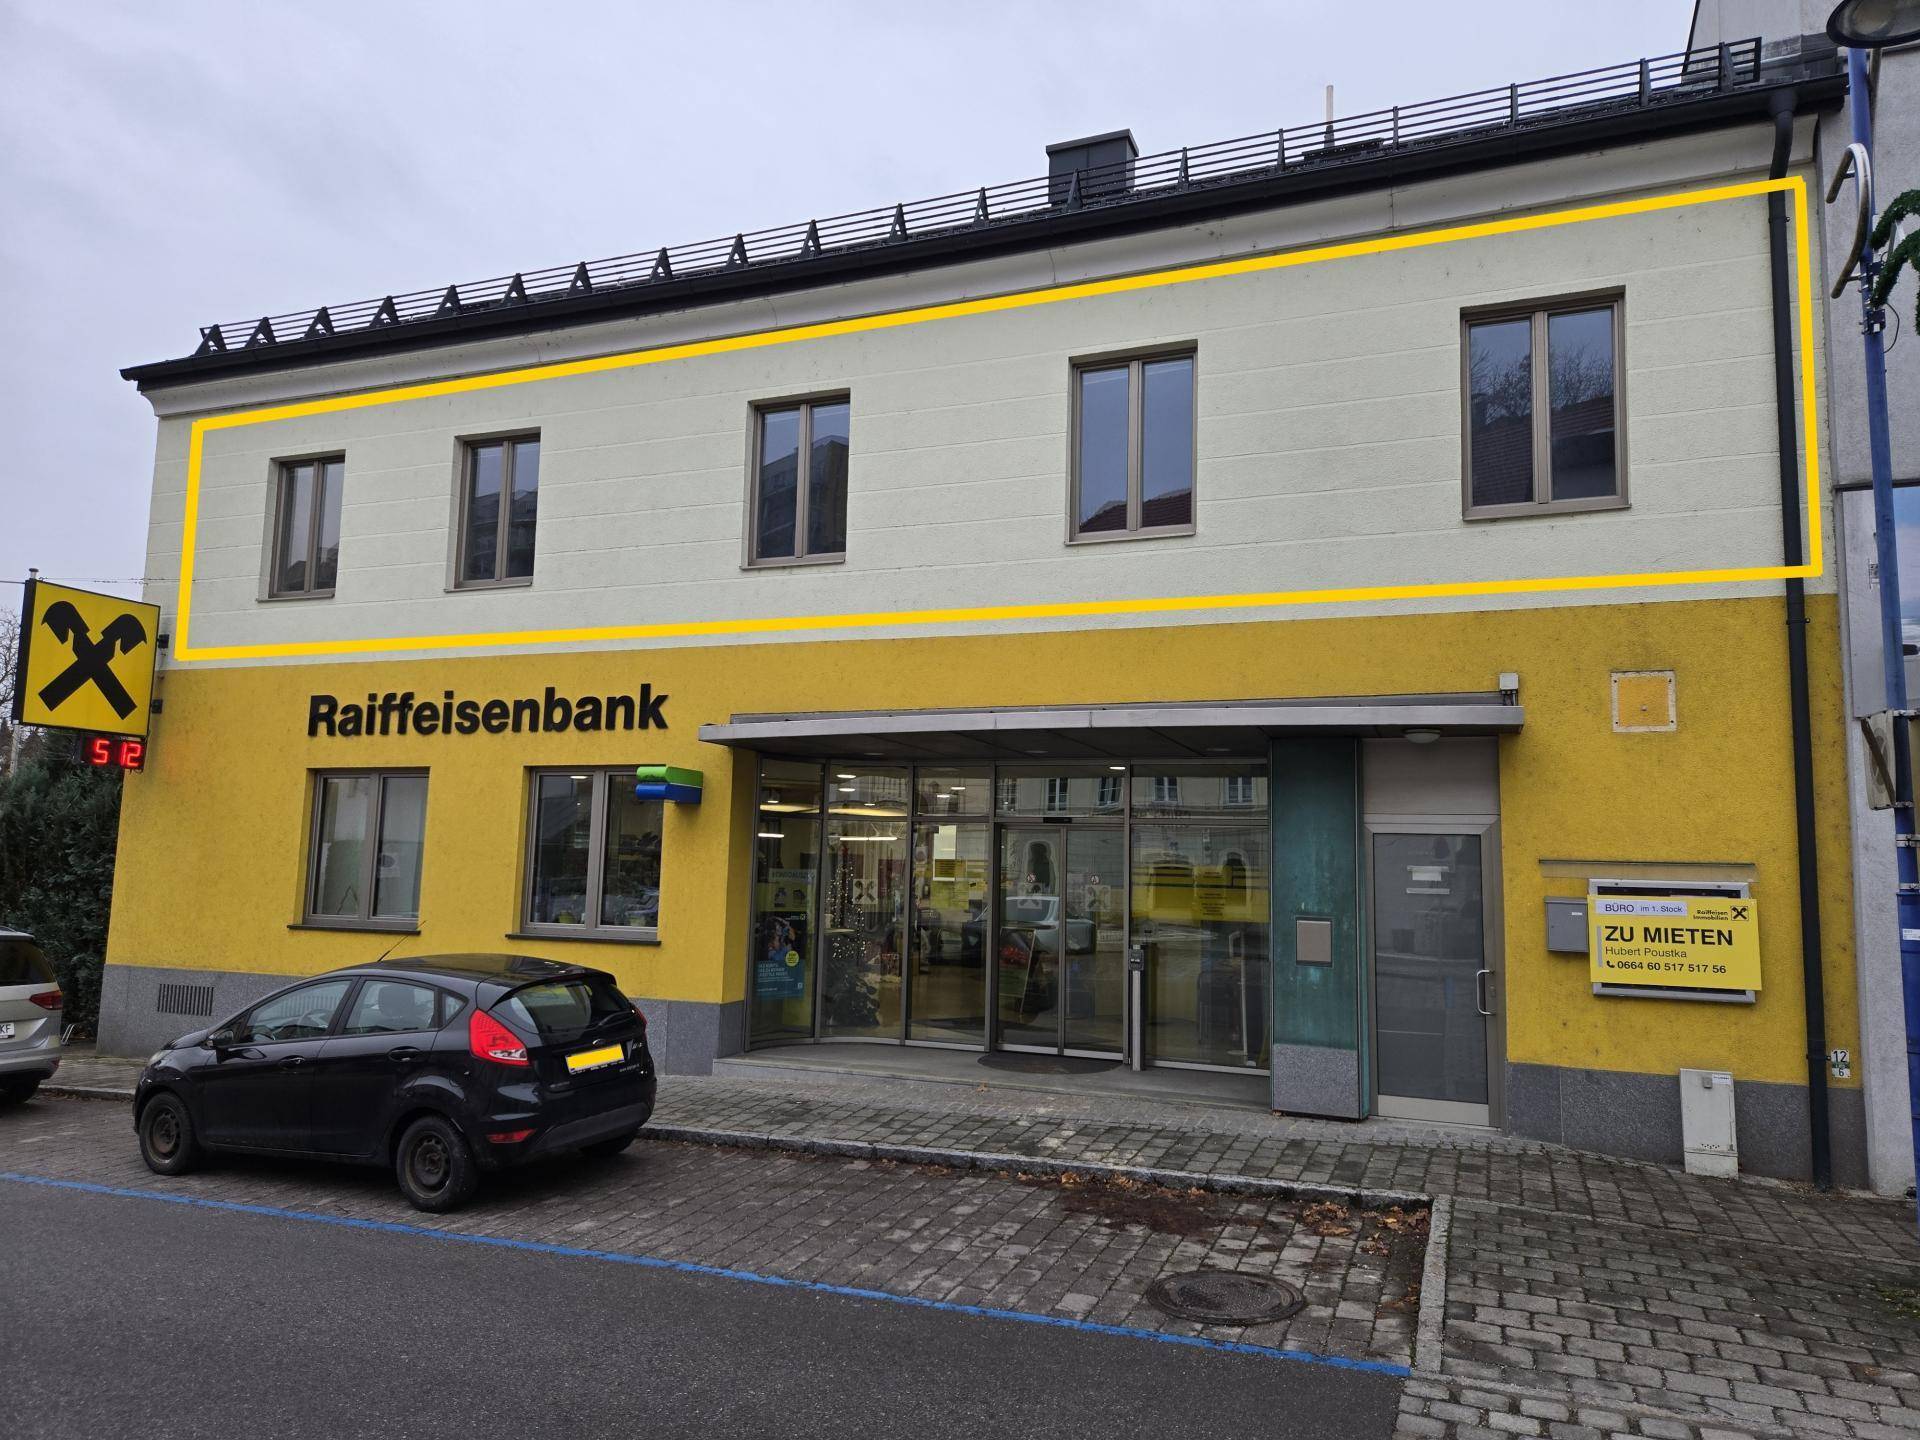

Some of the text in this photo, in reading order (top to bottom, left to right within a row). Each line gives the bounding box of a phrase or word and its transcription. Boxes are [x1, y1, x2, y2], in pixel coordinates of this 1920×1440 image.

[307, 683, 669, 737] Raiffeisenbank
[1605, 902, 1634, 912] BÜRO
[1605, 926, 1733, 945] ZU MIETEN
[1605, 946, 1687, 958] Hubert Poustka
[1617, 961, 1727, 974] 0664 60 517 517 56
[1833, 1051, 1847, 1063] 12
[1838, 1067, 1845, 1077] 6
